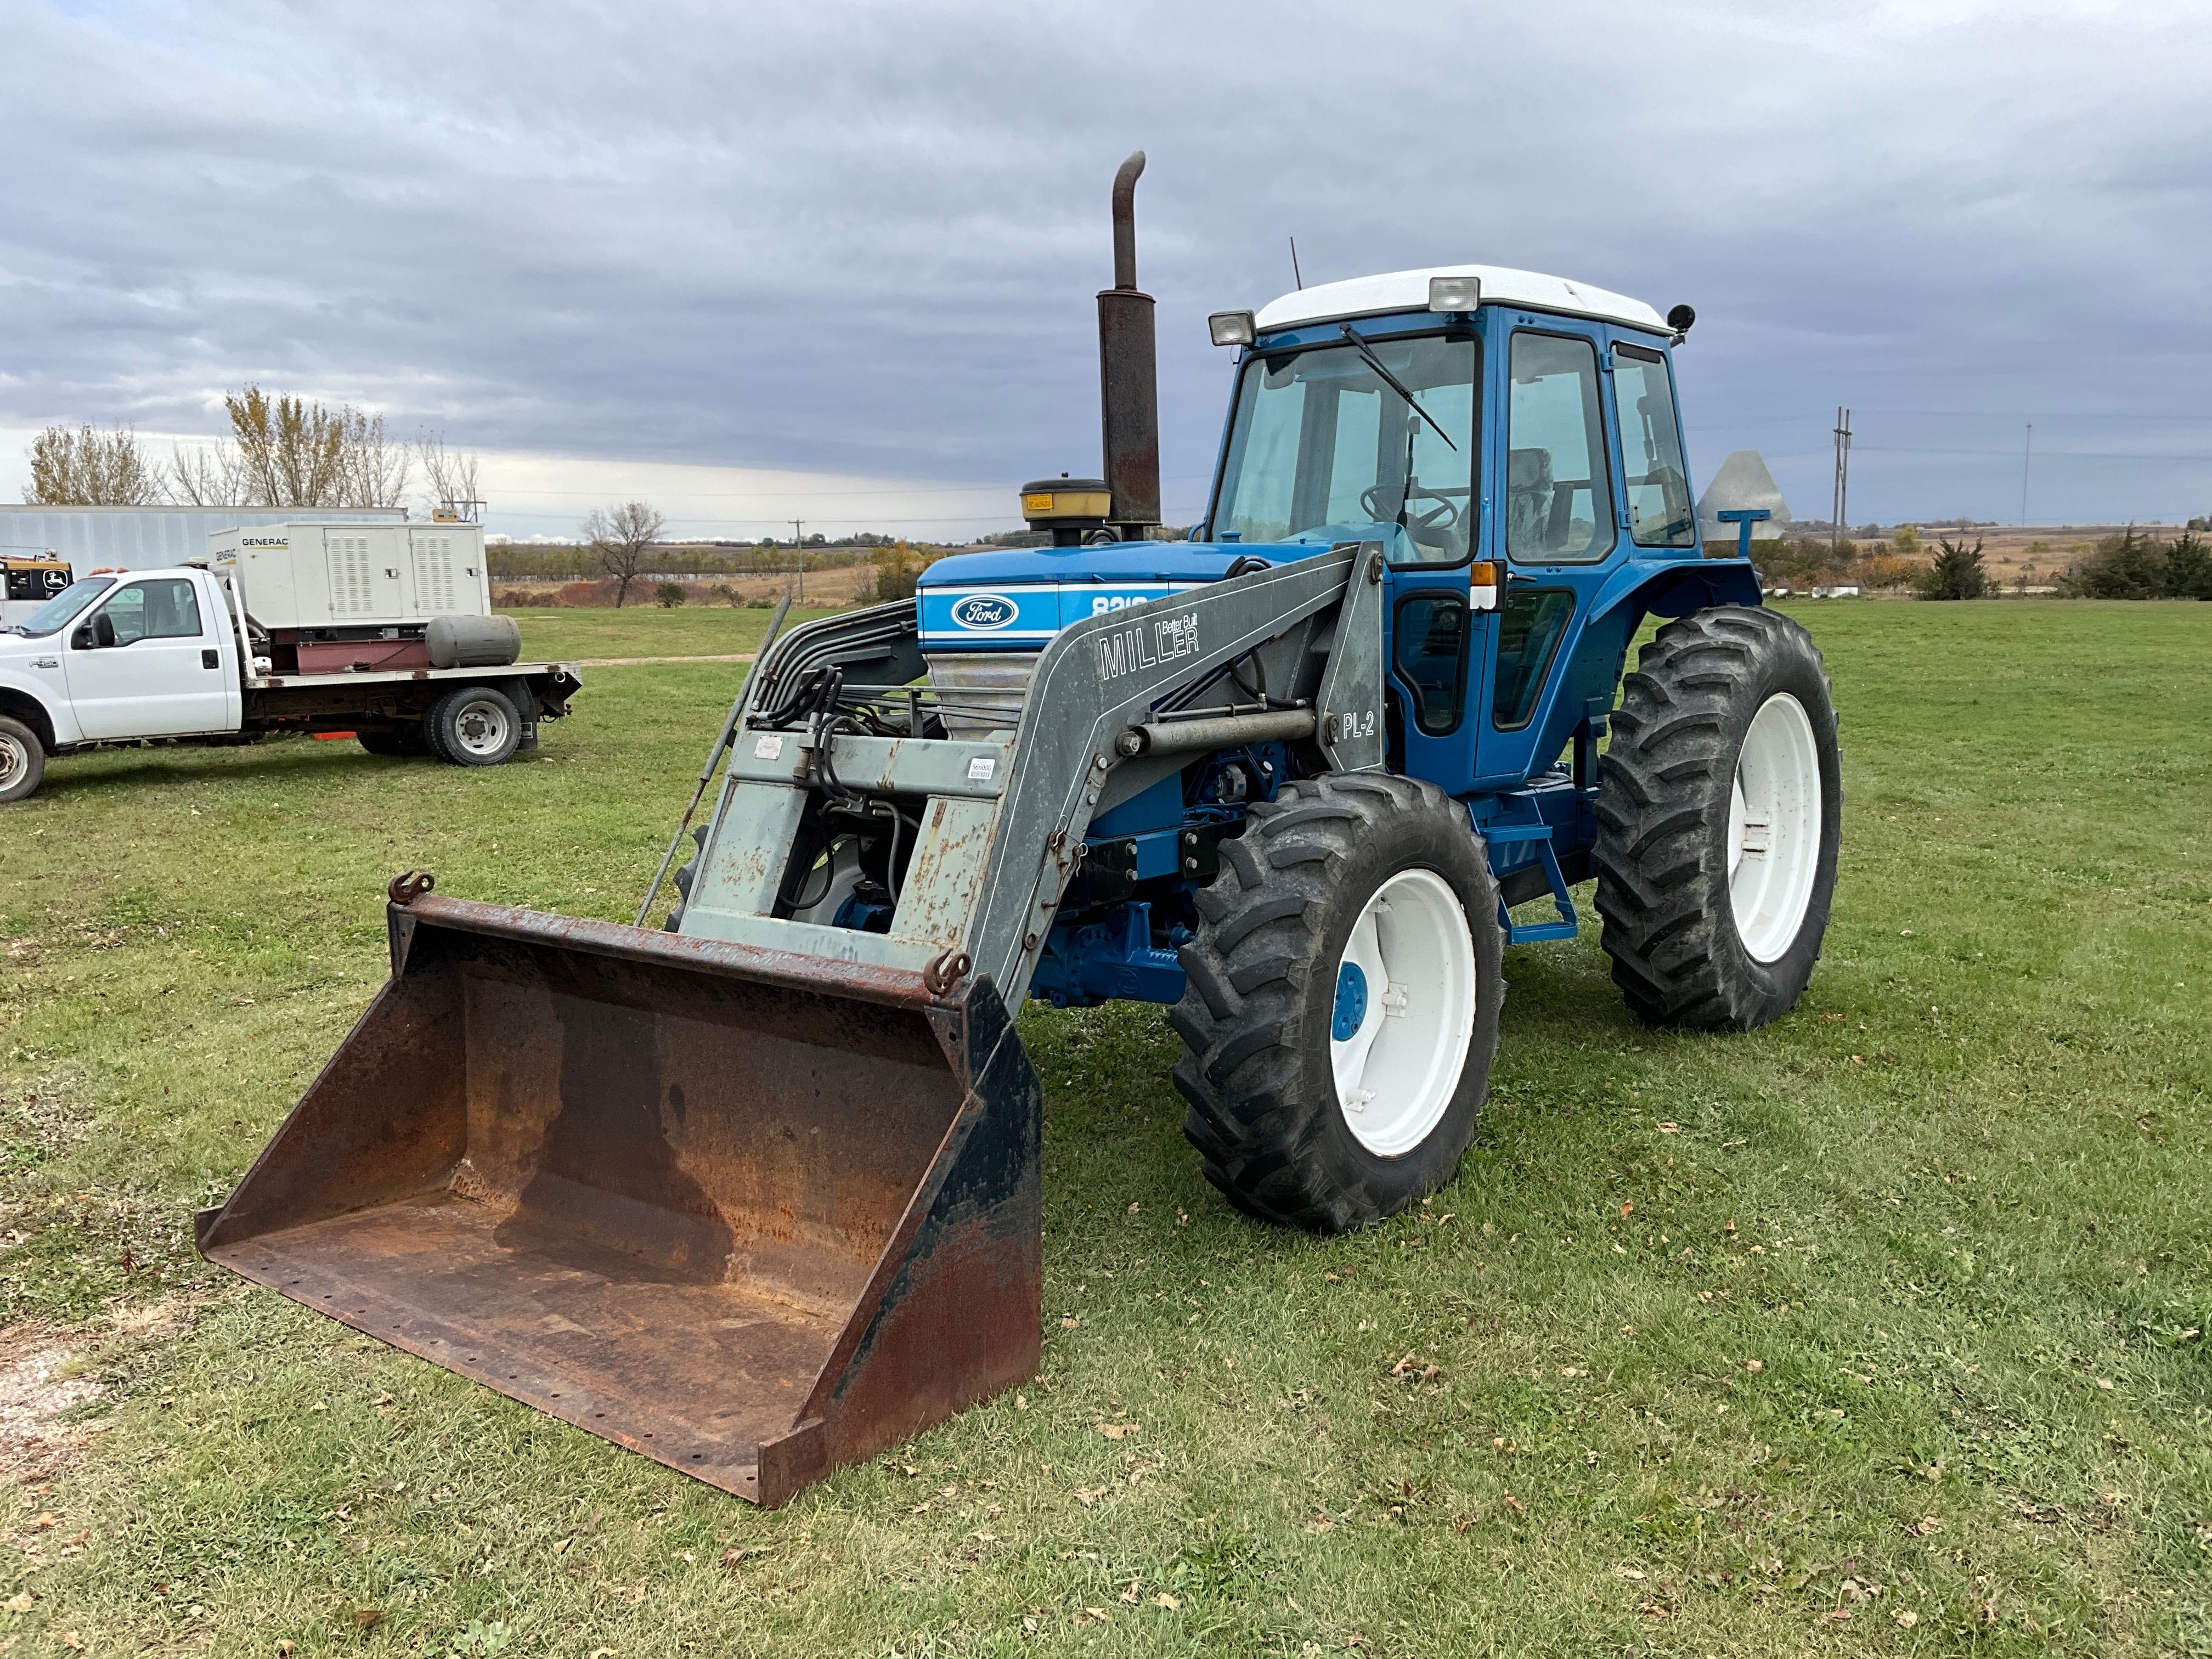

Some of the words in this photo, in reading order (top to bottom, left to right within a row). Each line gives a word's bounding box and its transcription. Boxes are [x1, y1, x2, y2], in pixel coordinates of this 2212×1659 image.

[216, 549, 236, 561] GENERAC
[966, 602, 1002, 621] Ford
[1162, 619, 1183, 635] Better
[1183, 612, 1198, 629] Built
[1099, 622, 1199, 681] MILLER
[1343, 710, 1374, 739] PL-2
